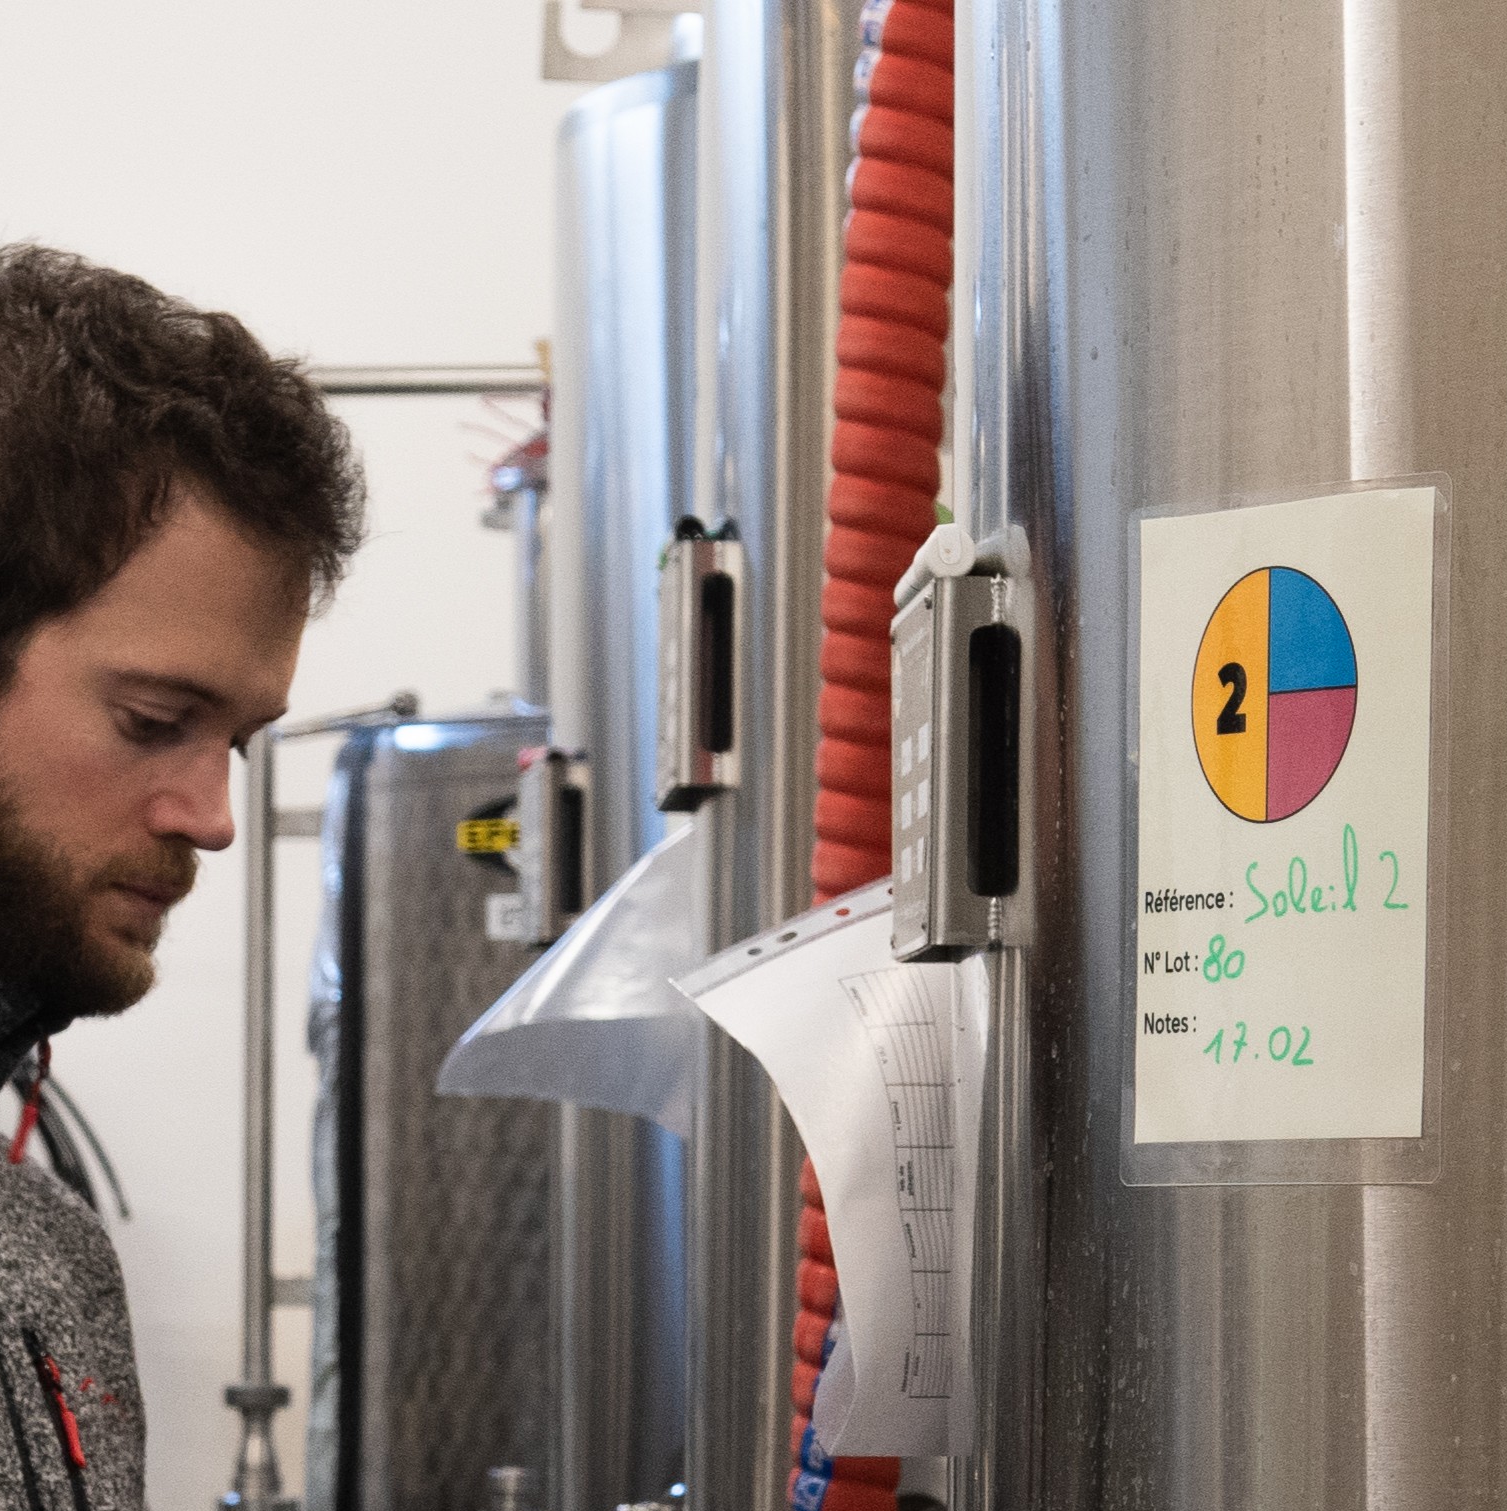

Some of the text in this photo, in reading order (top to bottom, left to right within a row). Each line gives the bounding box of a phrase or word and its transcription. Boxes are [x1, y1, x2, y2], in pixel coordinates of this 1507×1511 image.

[1216, 662, 1247, 735] 2
[1244, 823, 1359, 924] Soleil
[1379, 850, 1410, 910] 2
[1203, 934, 1245, 983] 80
[1203, 1020, 1314, 1067] 17.02
